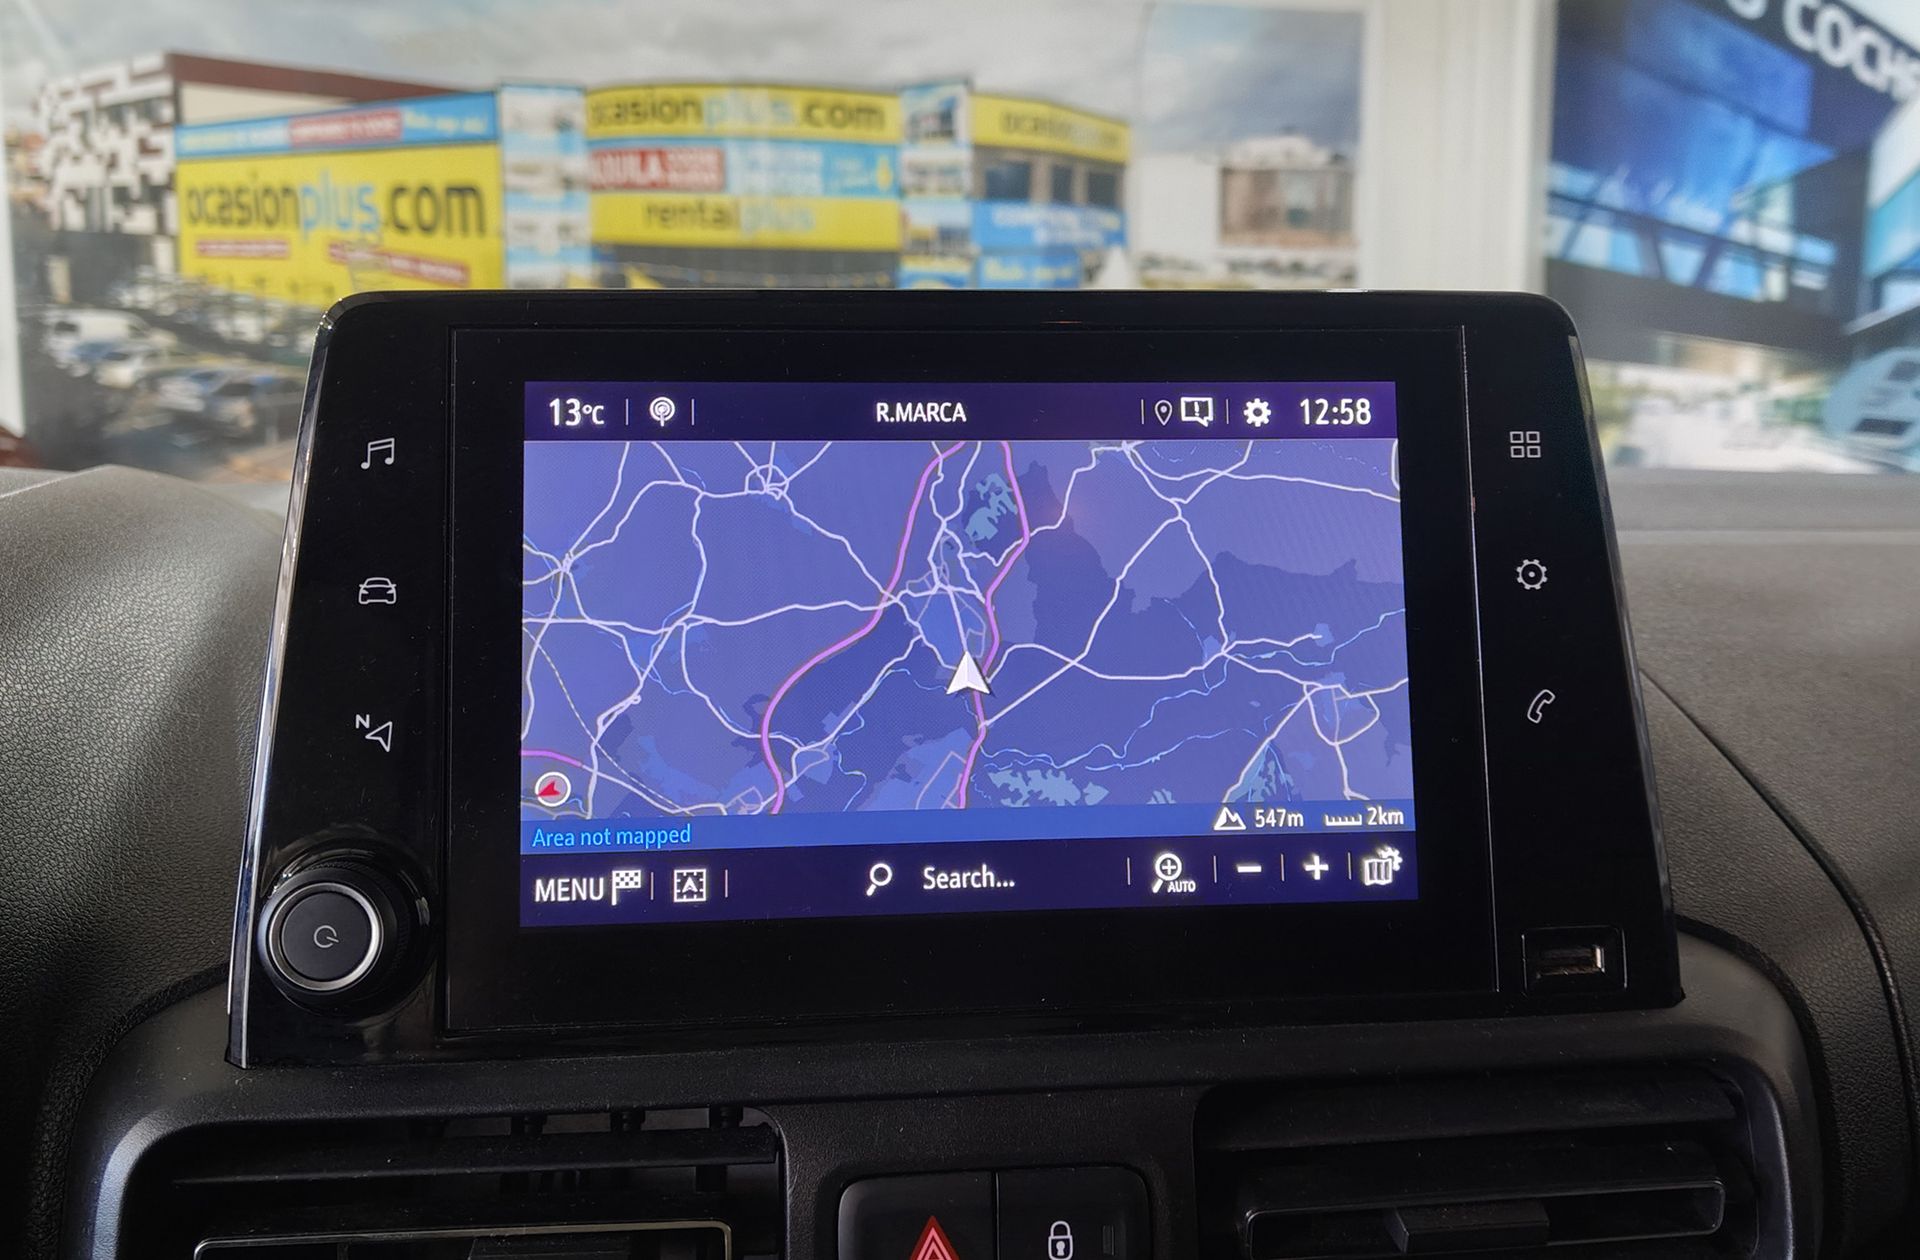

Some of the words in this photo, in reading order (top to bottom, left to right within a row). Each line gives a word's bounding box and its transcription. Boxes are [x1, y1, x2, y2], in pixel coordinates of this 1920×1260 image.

[876, 401, 967, 423] R.MARCA
[1299, 397, 1372, 425] 12:58
[1255, 808, 1304, 828] 547m
[1366, 805, 1405, 826] 2km
[530, 825, 575, 848] Area
[580, 827, 611, 846] not
[616, 823, 692, 849] mapped
[923, 863, 1015, 890] Search...
[1167, 880, 1196, 893] AUTO
[534, 876, 604, 903] MENU
